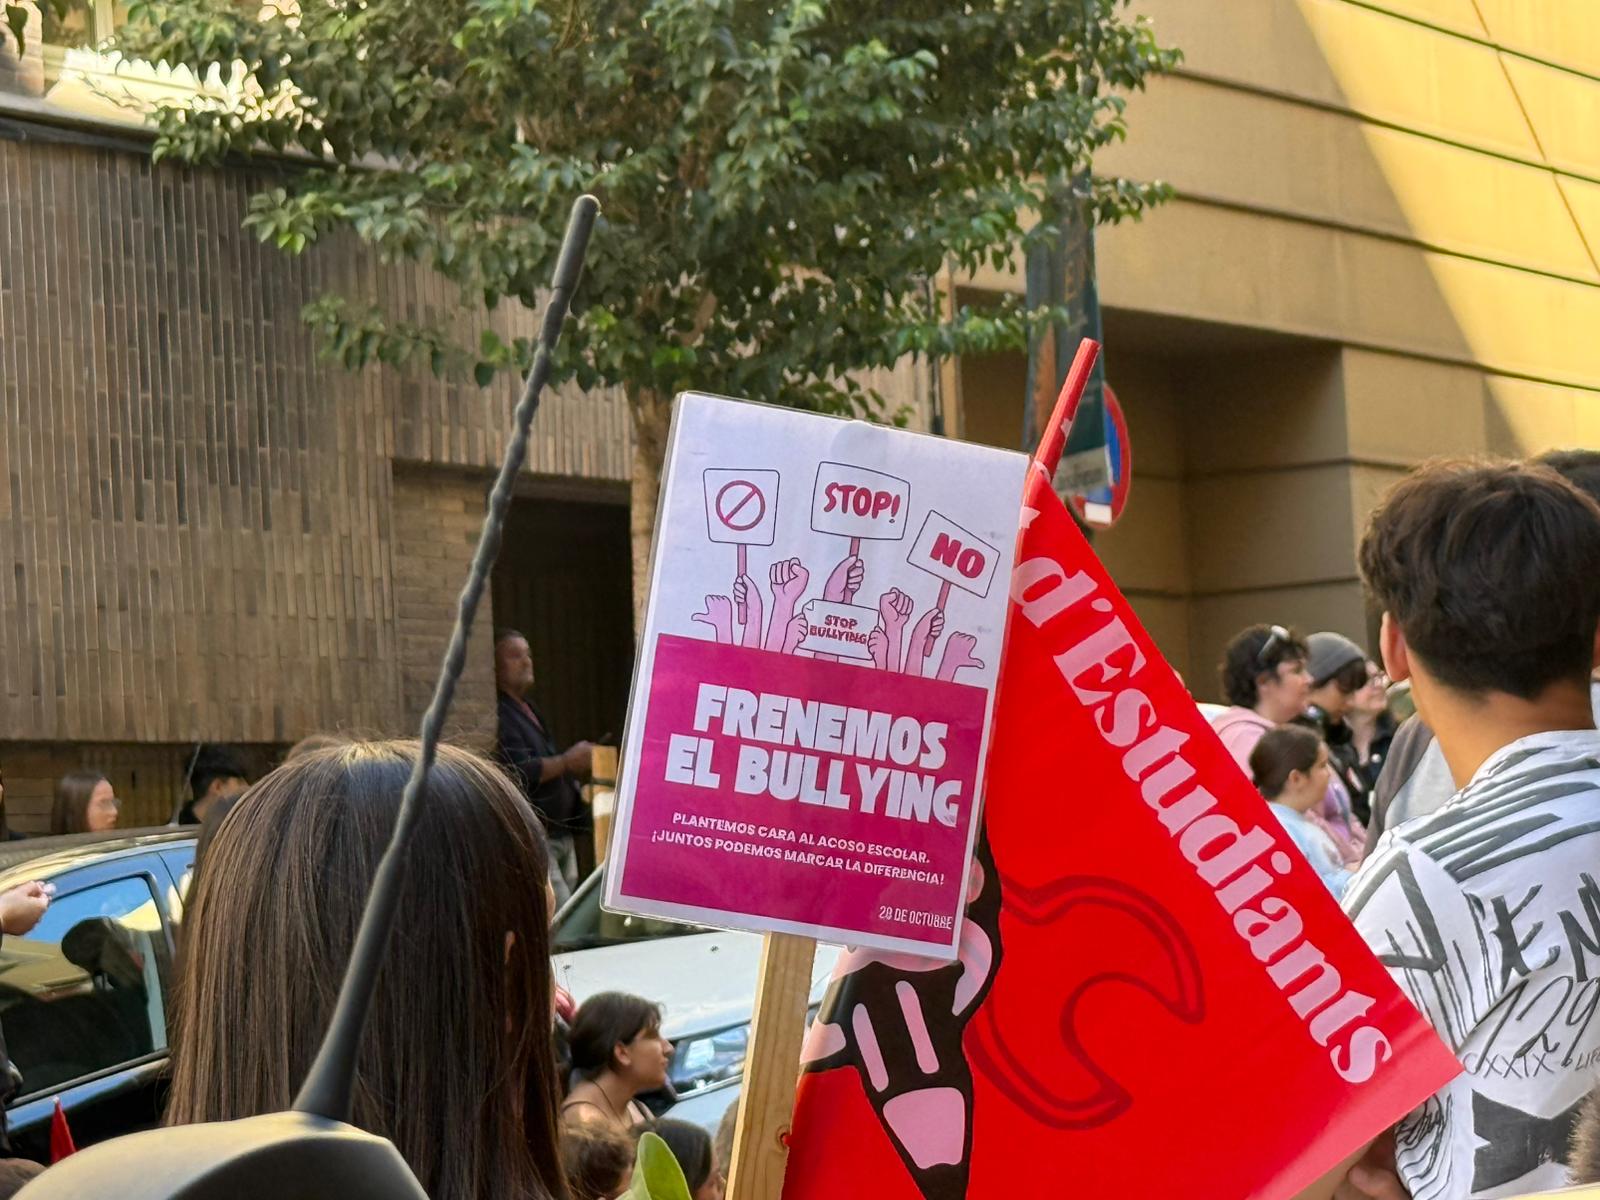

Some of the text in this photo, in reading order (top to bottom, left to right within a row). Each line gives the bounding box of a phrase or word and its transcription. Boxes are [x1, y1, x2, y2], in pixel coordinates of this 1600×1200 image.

[823, 481, 900, 524] STOP!
[930, 532, 986, 579] NO
[810, 625, 867, 645] BULLYING
[825, 614, 858, 630] STOP
[693, 682, 948, 770] FRENEMOS
[664, 733, 963, 828] EL BULLYING
[672, 812, 930, 864] PLANTEMOS CARA AL ACOSO ESCOLAR.
[1010, 555, 1393, 1084] d'Estudiants
[651, 829, 945, 886] ¡JUNTOS PODEMOS MARCAR LA DIFERENCIA!
[894, 907, 908, 922] DE
[909, 910, 953, 930] OCTUBRE
